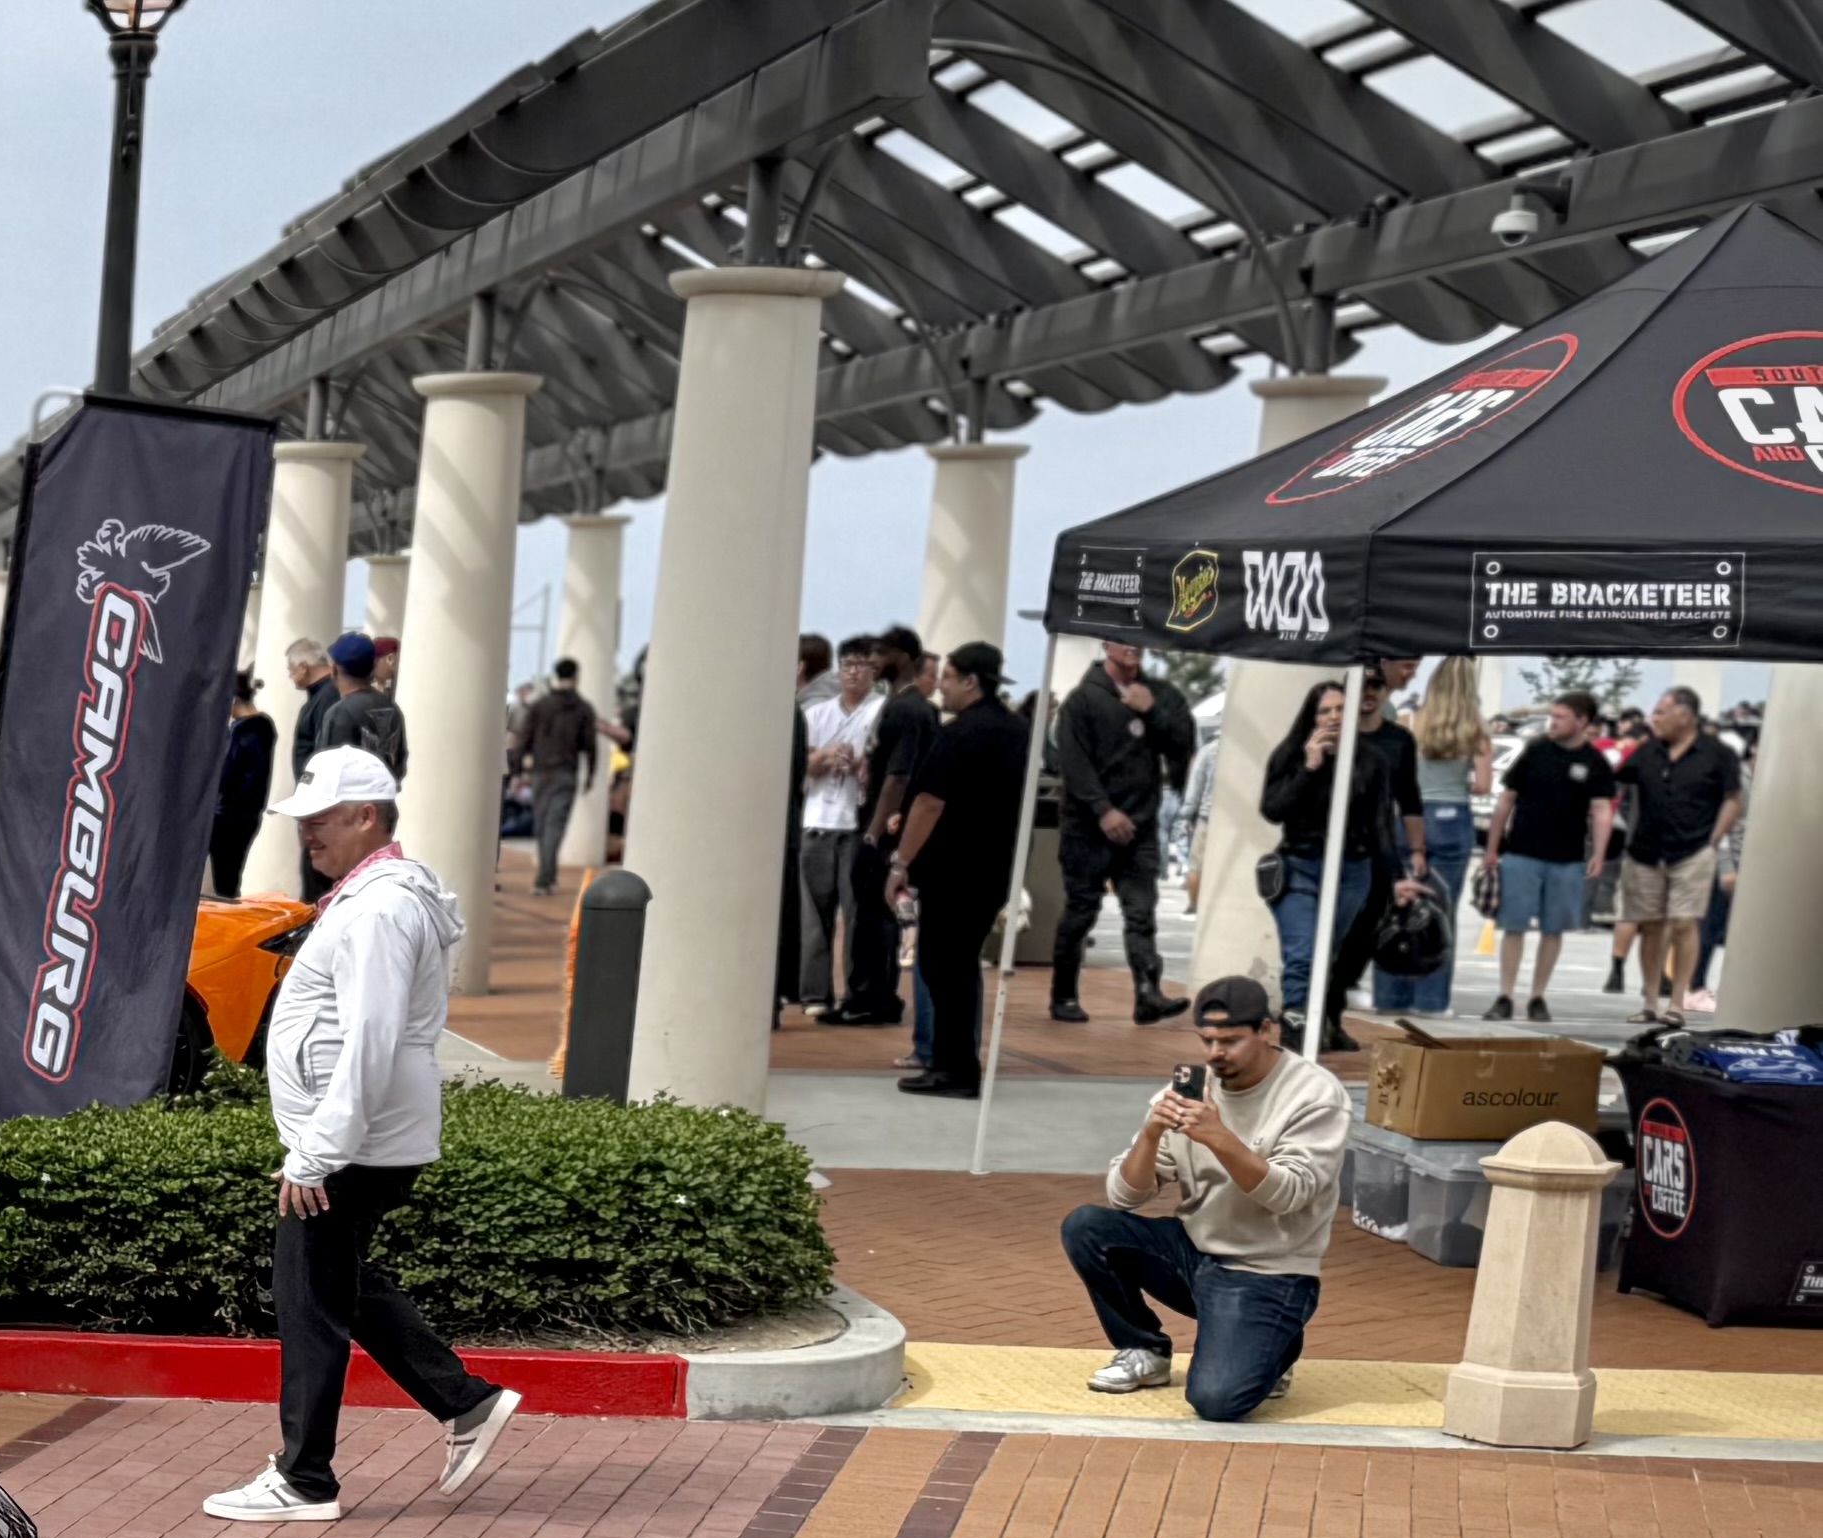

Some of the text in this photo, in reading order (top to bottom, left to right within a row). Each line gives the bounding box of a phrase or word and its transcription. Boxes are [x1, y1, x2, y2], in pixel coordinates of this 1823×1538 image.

[1351, 388, 1517, 449] CARS
[1752, 444, 1806, 462] AND
[1484, 609, 1556, 620] AUTOMOTIVE
[1558, 609, 1585, 620] FIRE
[1670, 610, 1731, 621] BRACKETS
[1485, 582, 1731, 607] THE BRACKETEER
[30, 590, 137, 1075] CAMBURG
[1642, 1133, 1685, 1191] CARS
